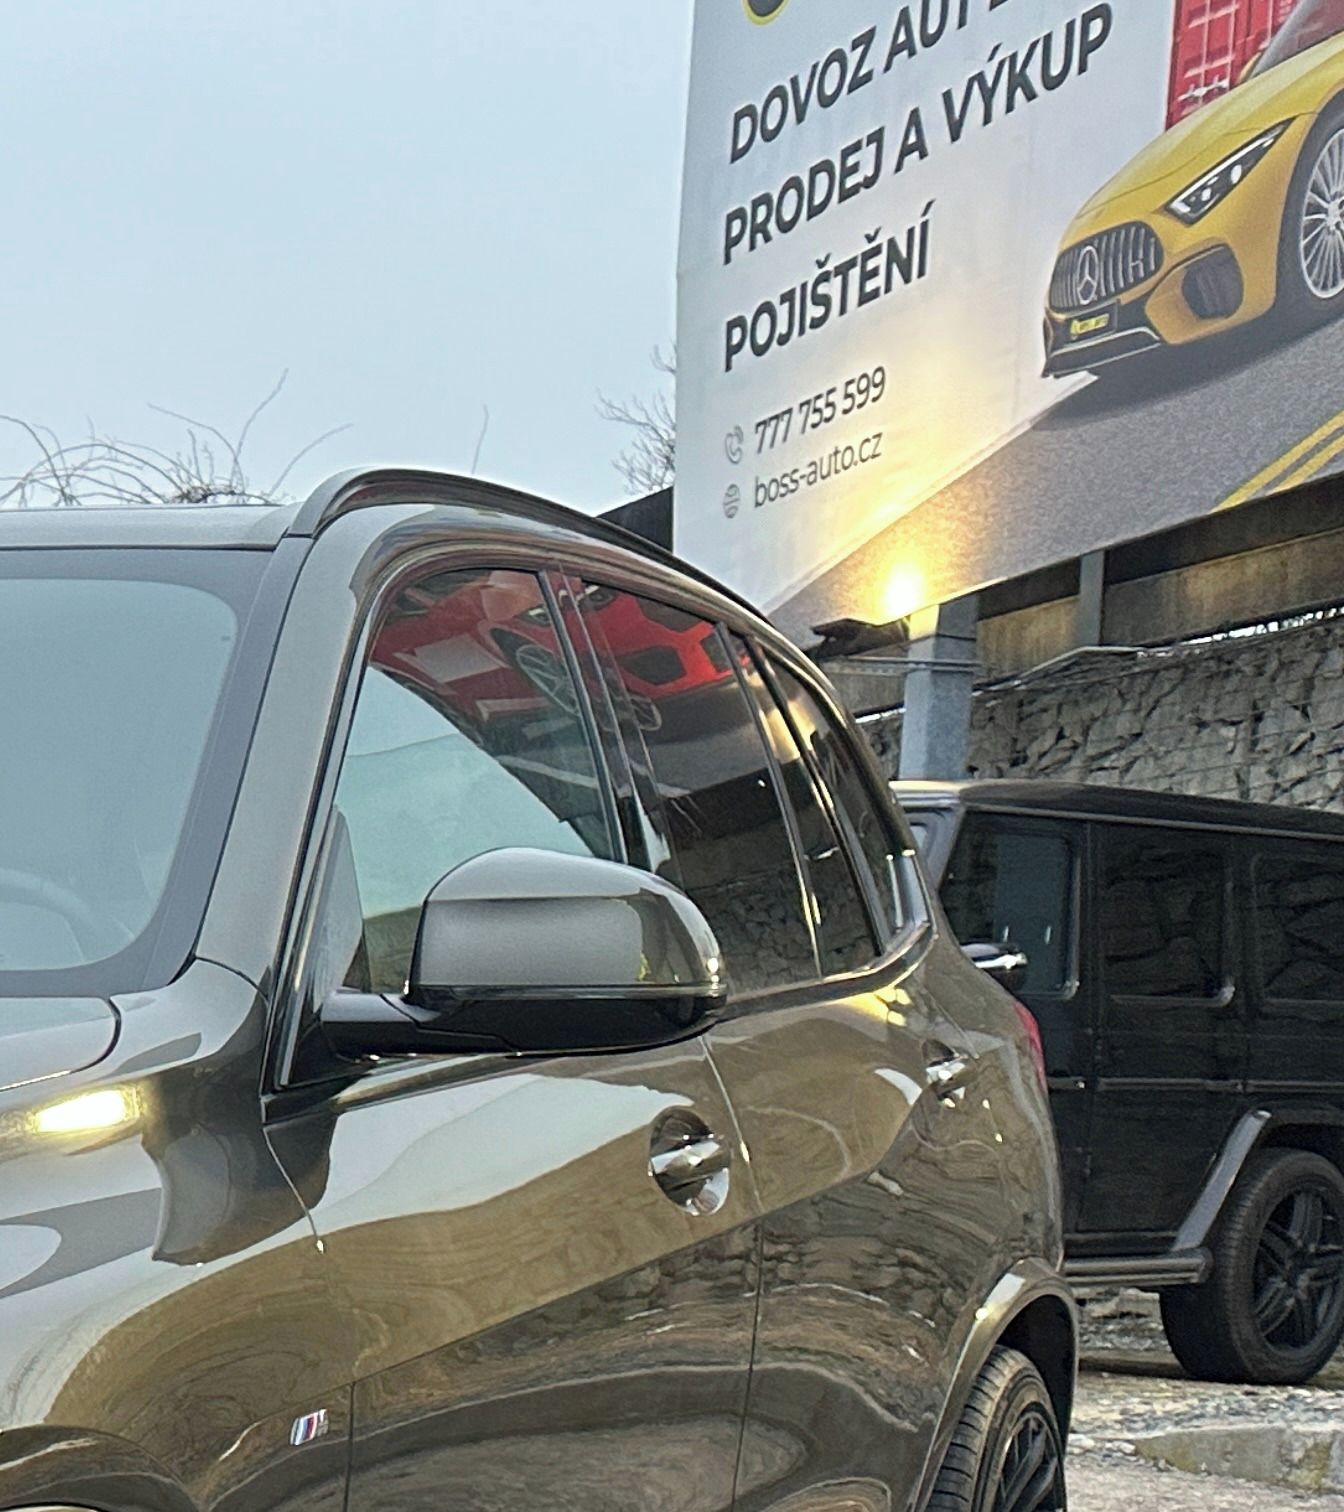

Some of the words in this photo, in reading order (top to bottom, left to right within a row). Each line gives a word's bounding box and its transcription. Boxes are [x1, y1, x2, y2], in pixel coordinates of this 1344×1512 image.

[722, 126, 886, 266] PRODEJ
[894, 106, 929, 175] A
[941, 2, 1113, 144] VÝKUP
[730, 25, 878, 165] DOVOZ
[723, 199, 936, 374] POJIŠTĚNÍ
[754, 407, 793, 455] 777
[798, 387, 837, 435] 755
[841, 366, 887, 416] 599
[754, 432, 884, 508] boss-auto.cz
